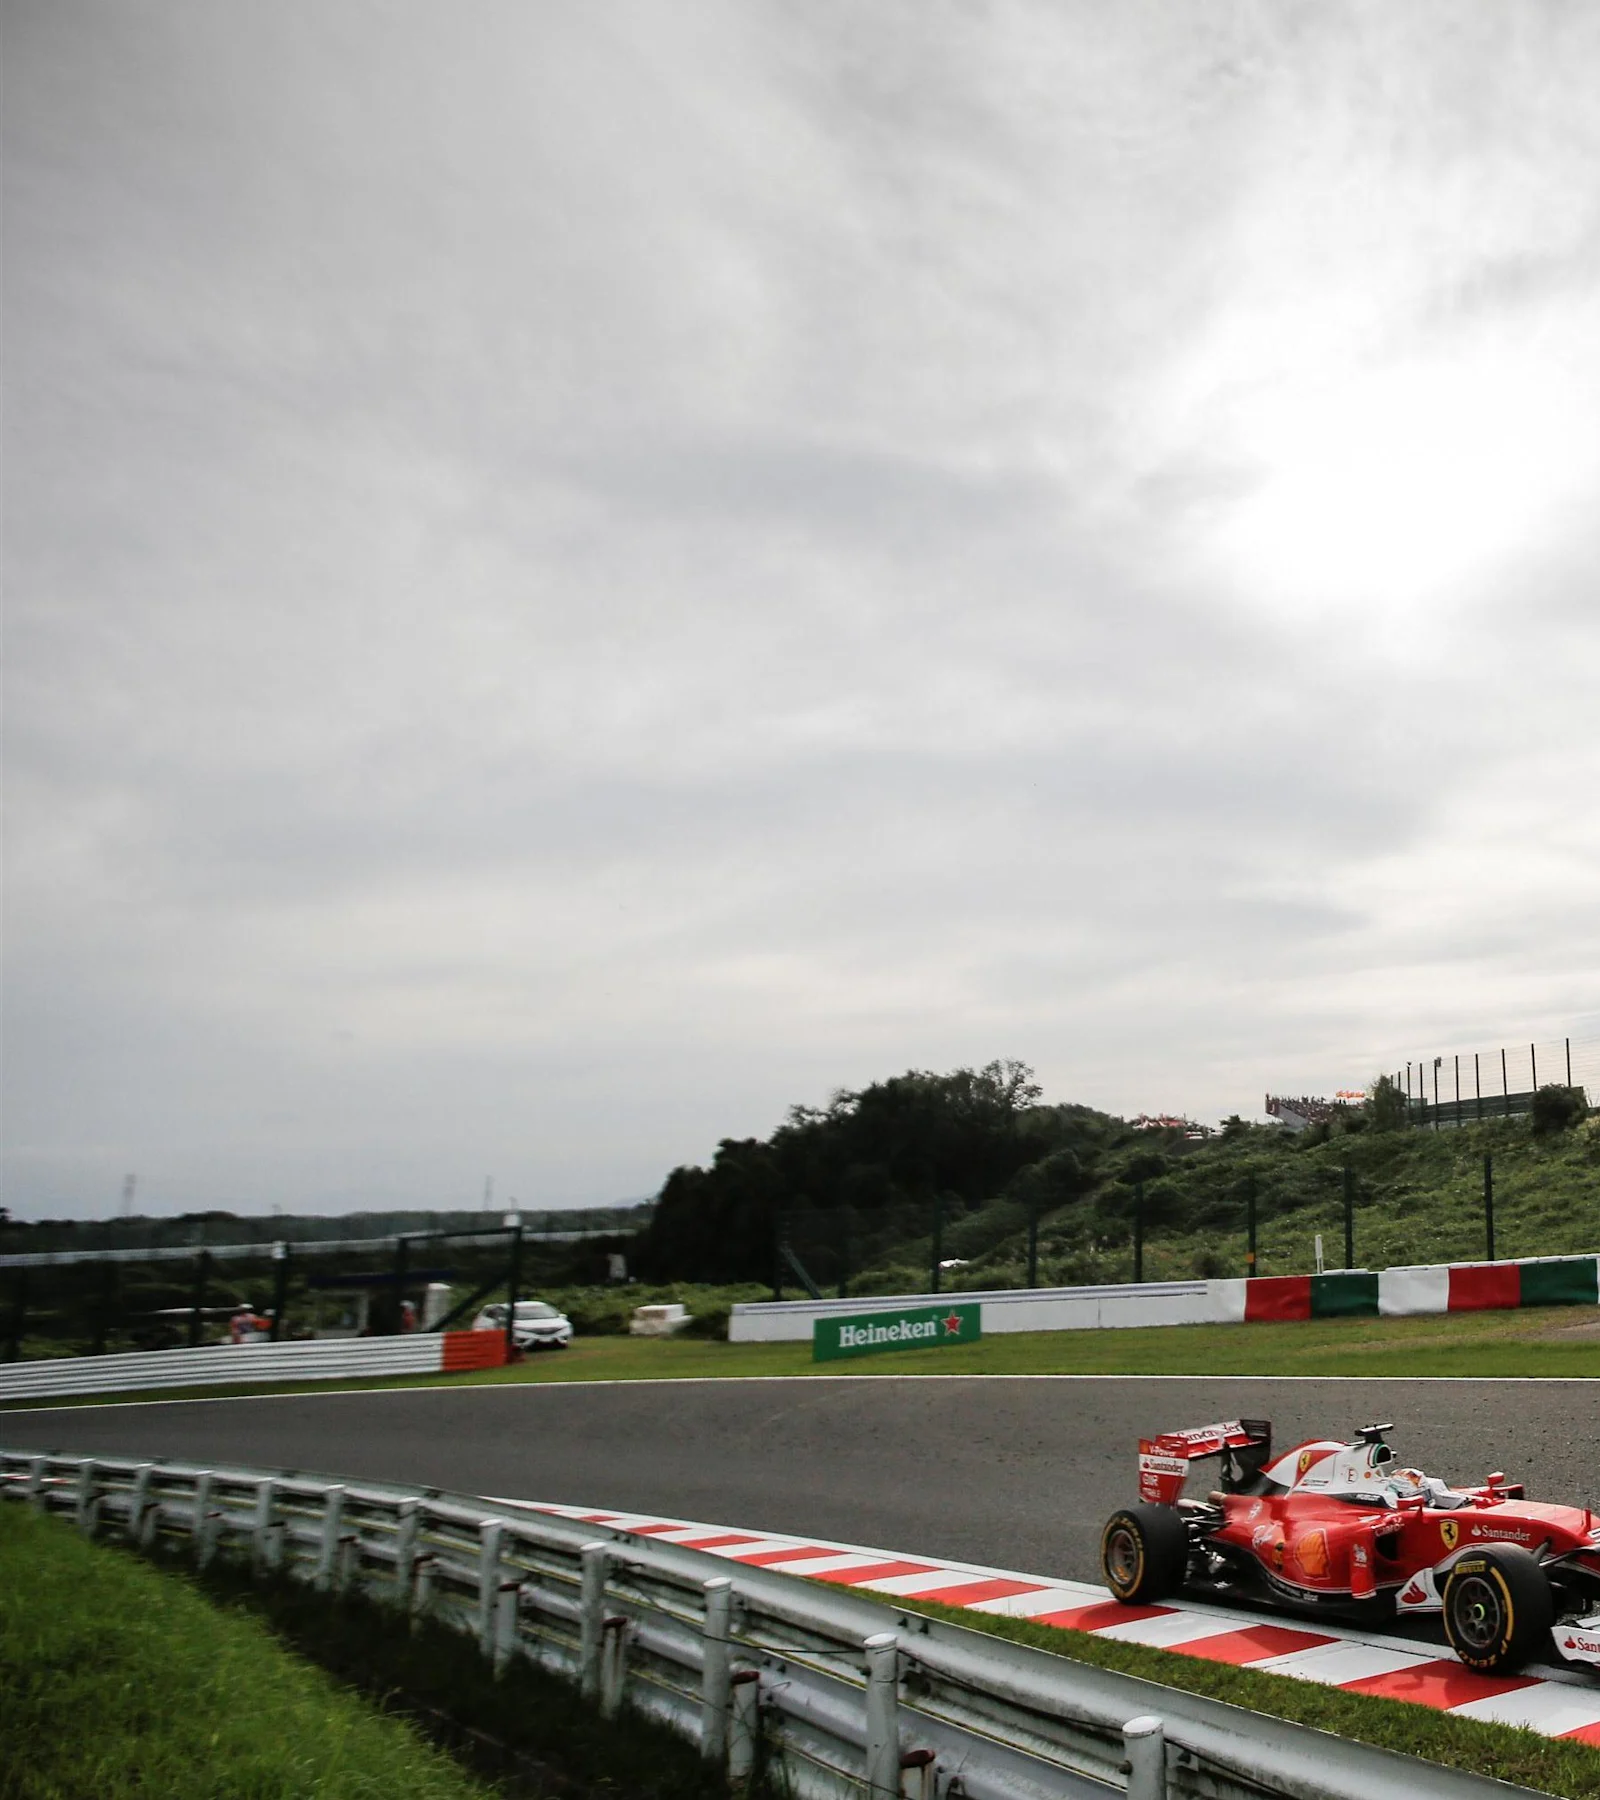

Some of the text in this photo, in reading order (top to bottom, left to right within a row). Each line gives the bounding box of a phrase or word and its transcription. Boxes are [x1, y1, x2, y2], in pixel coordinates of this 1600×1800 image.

[838, 1319, 937, 1348] Heineken
[1150, 1458, 1184, 1474] Santander
[1481, 1524, 1531, 1541] Santander
